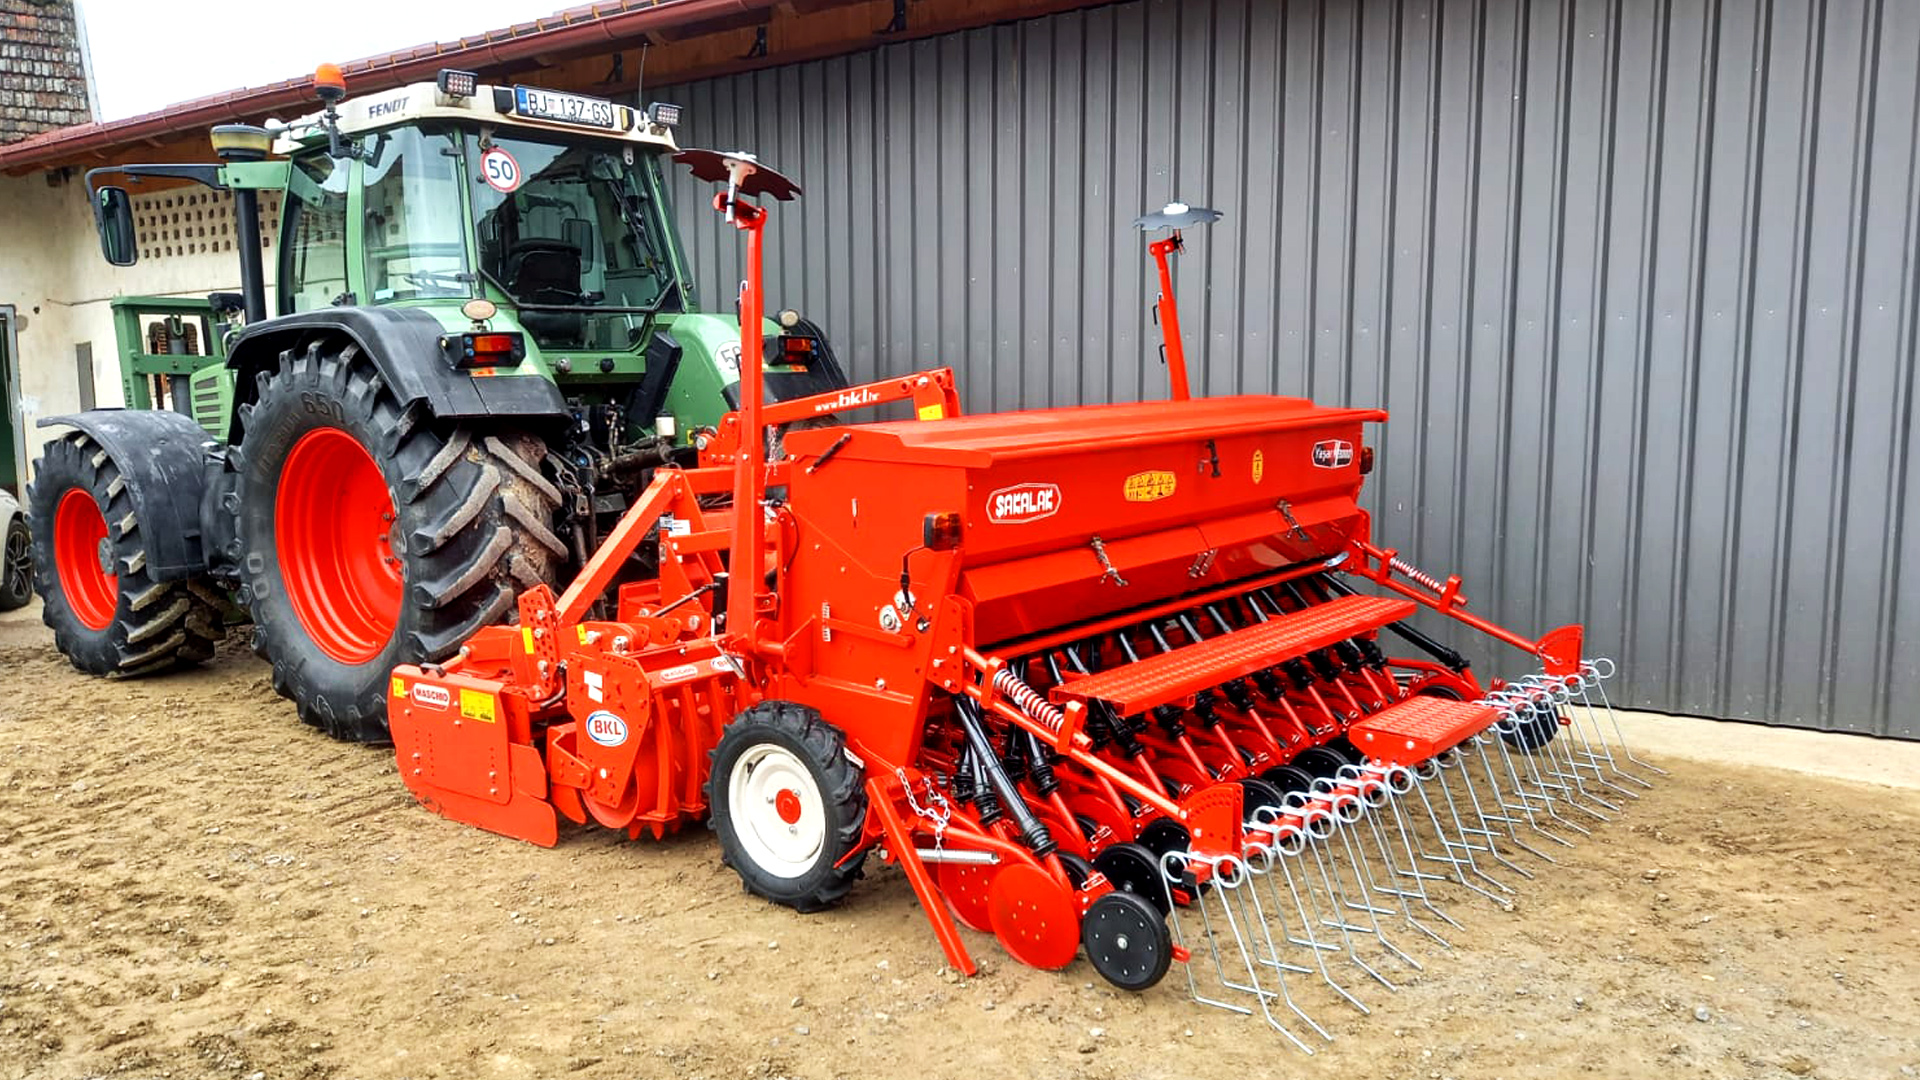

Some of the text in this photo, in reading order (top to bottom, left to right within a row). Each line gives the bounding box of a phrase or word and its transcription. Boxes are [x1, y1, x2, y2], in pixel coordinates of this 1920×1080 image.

[368, 96, 410, 119] FENDT
[528, 93, 547, 113] BJ
[488, 158, 514, 181] 50
[415, 687, 449, 703] MASCHIO
[594, 719, 622, 736] BKL
